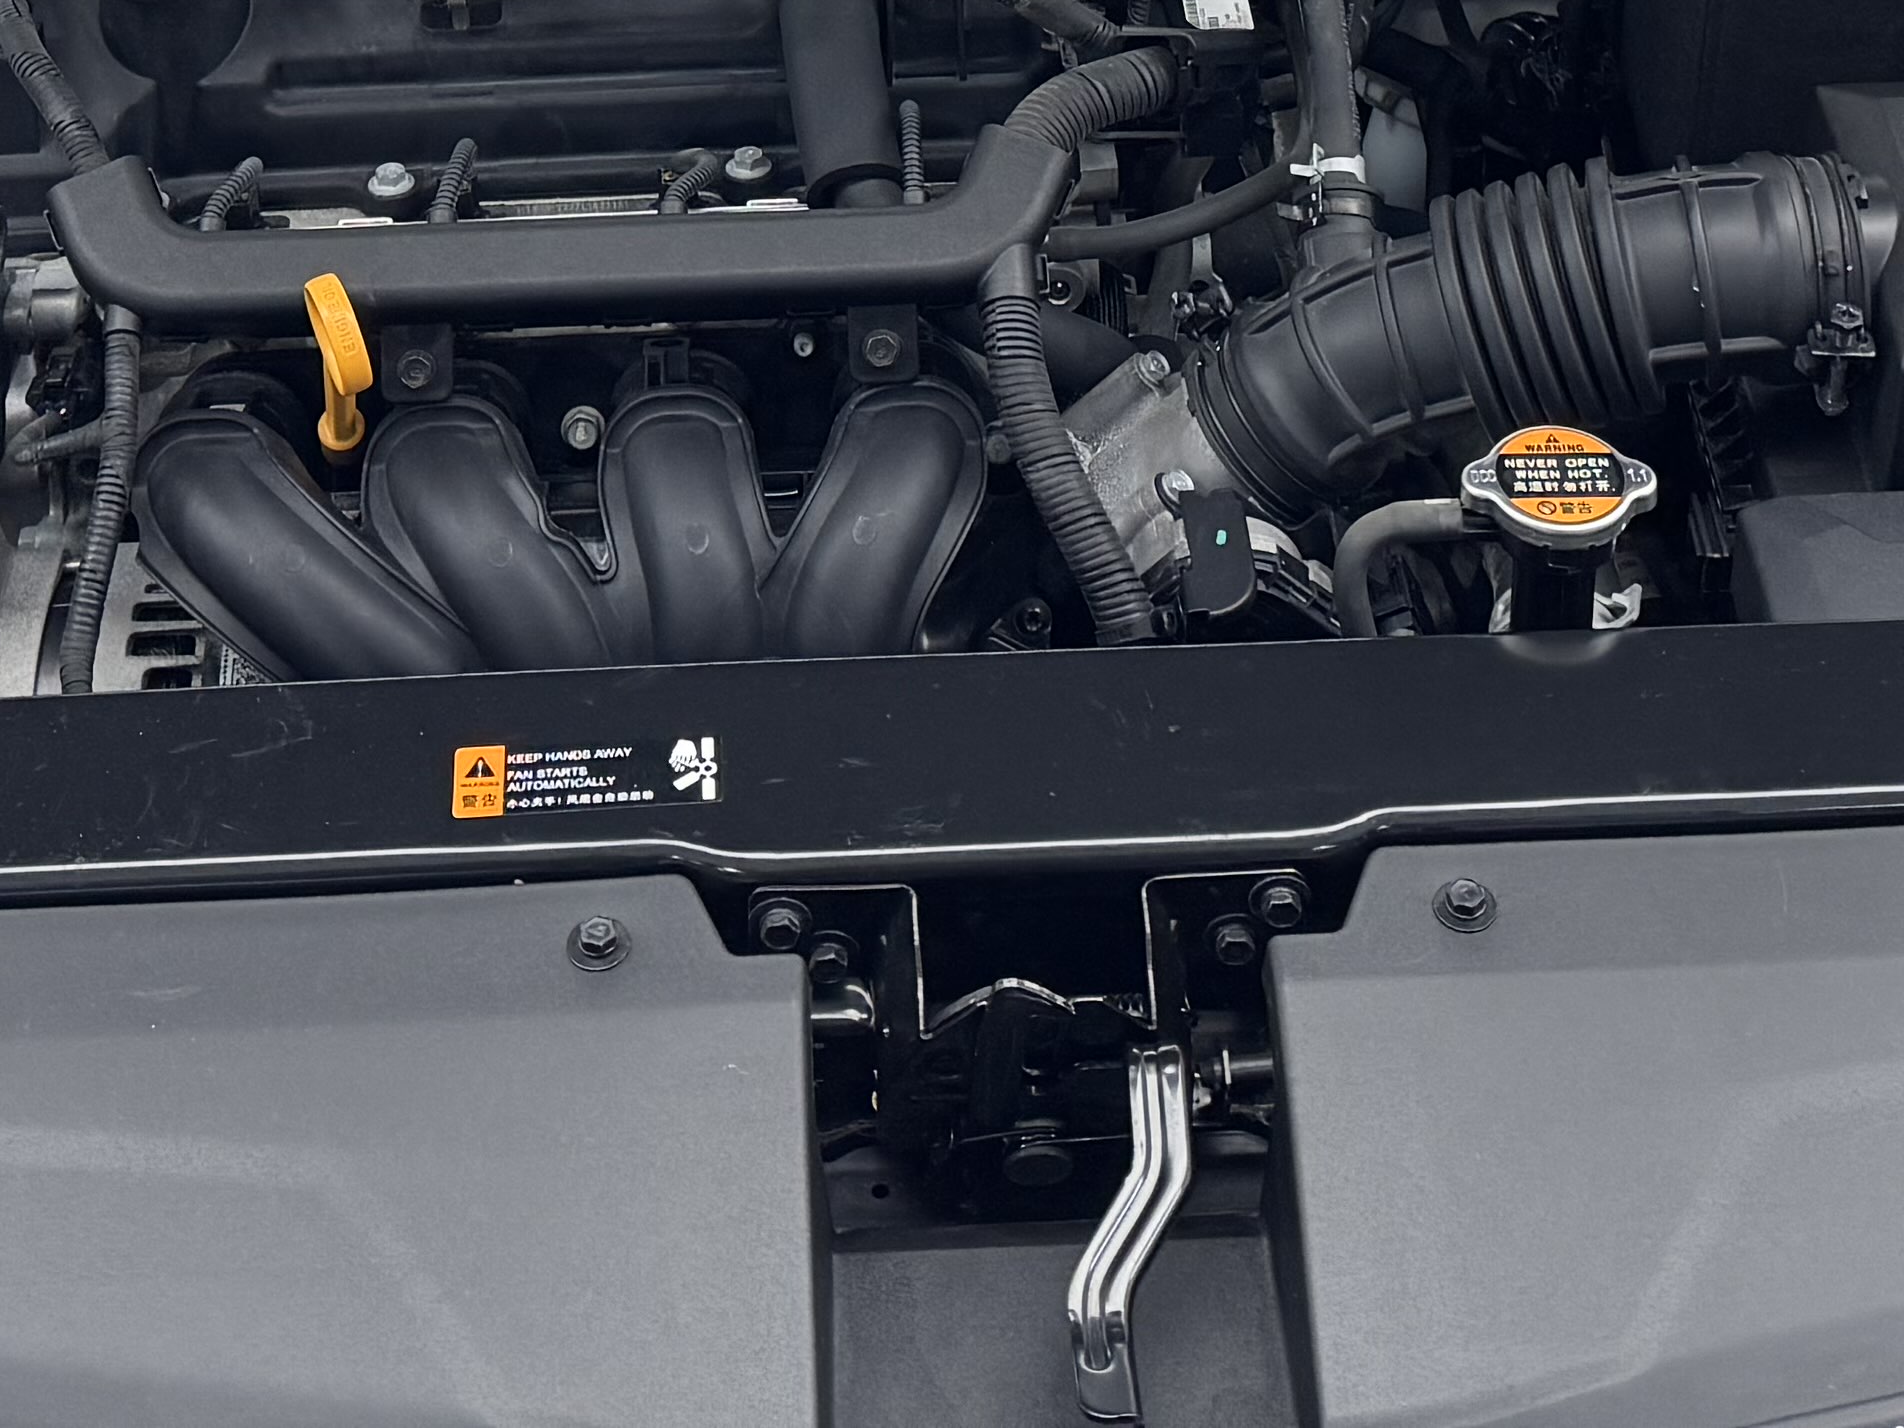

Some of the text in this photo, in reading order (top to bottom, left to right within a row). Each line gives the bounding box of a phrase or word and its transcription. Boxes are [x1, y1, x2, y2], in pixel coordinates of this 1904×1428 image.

[1525, 444, 1585, 453] WARNING
[1505, 458, 1609, 468] NEVER OPEN
[1516, 469, 1560, 480] WHEN
[1627, 468, 1647, 482] 1.1
[1560, 501, 1592, 514] 警告
[507, 747, 633, 765] KEEP HANDS AWAY
[507, 766, 588, 780] FAN STARTS
[507, 776, 616, 792] AUTOMATICALLY
